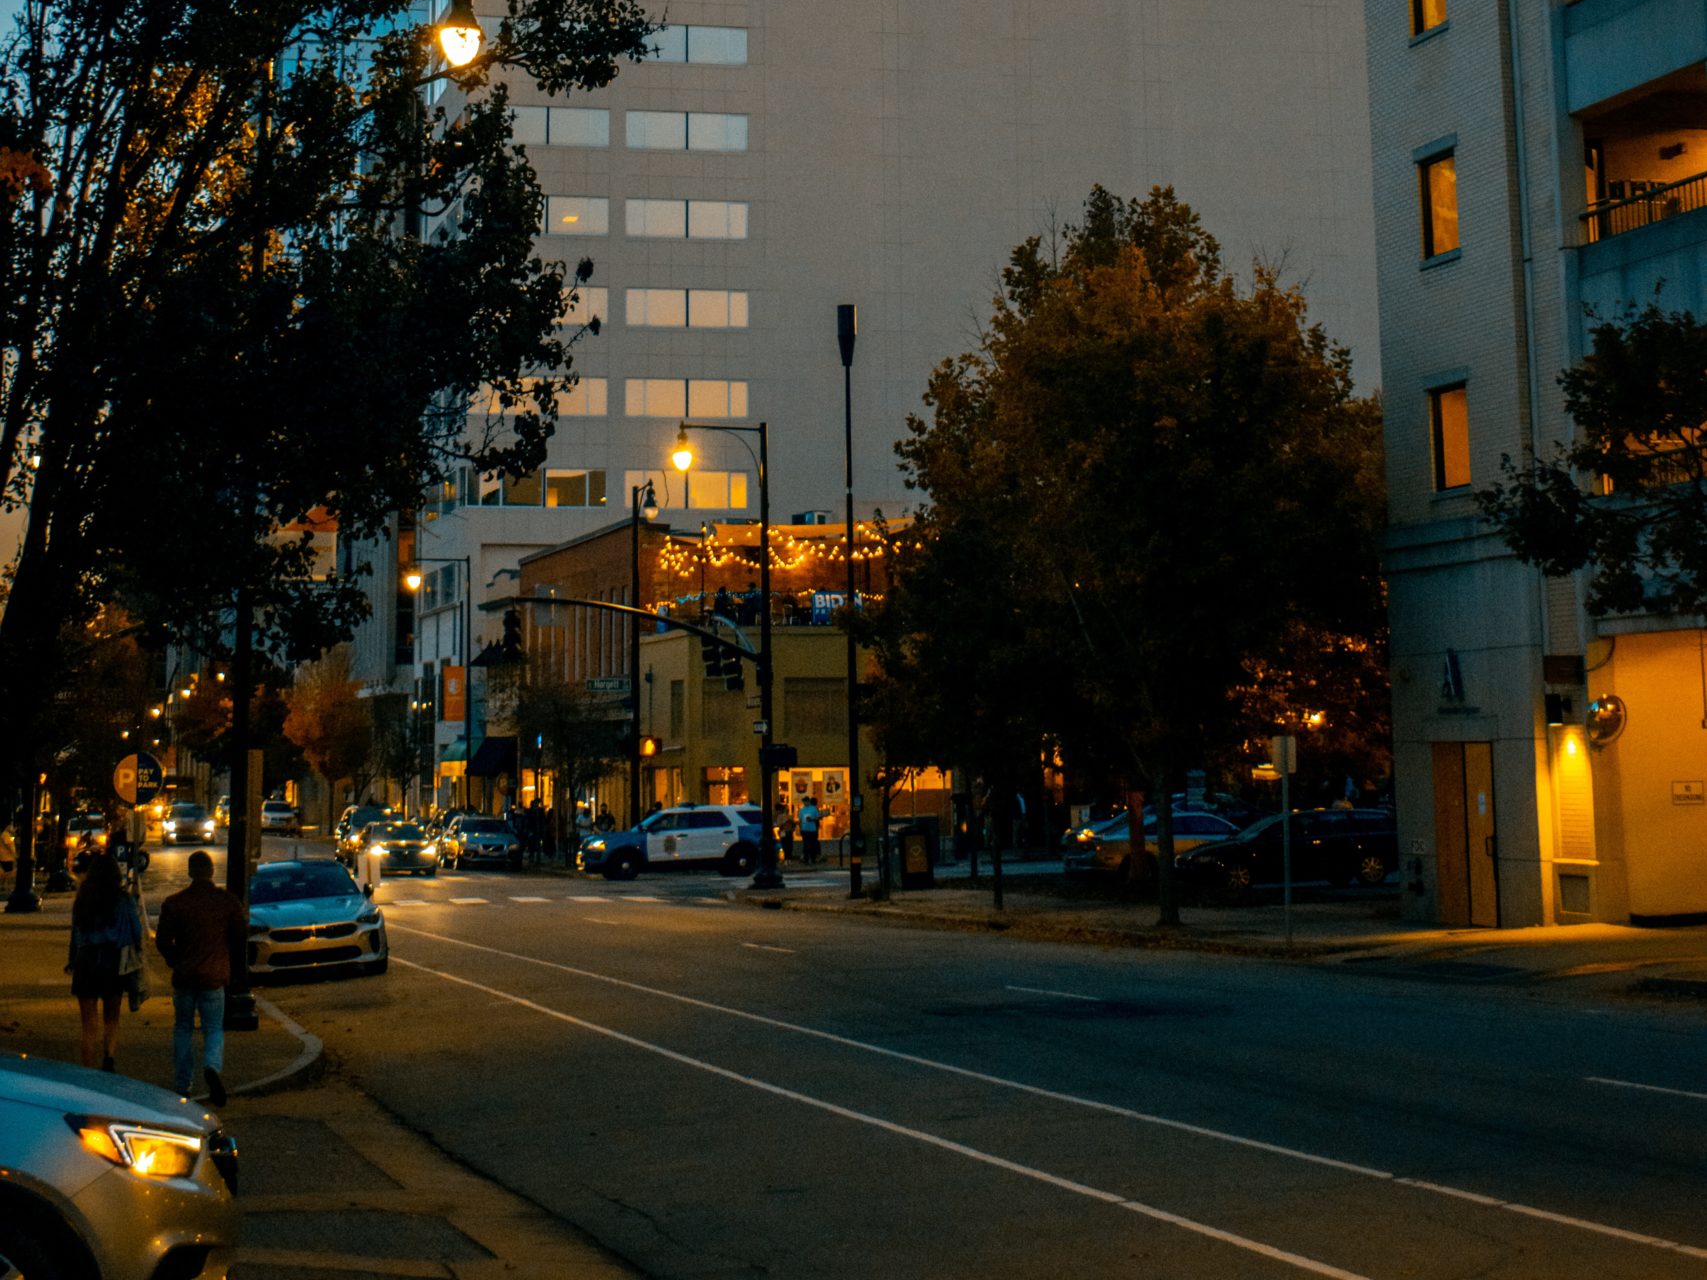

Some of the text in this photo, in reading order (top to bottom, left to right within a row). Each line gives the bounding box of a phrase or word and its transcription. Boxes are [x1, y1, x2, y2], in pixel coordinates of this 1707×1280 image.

[814, 594, 863, 609] BIDN
[118, 768, 135, 789] P
[138, 781, 159, 789] PARK
